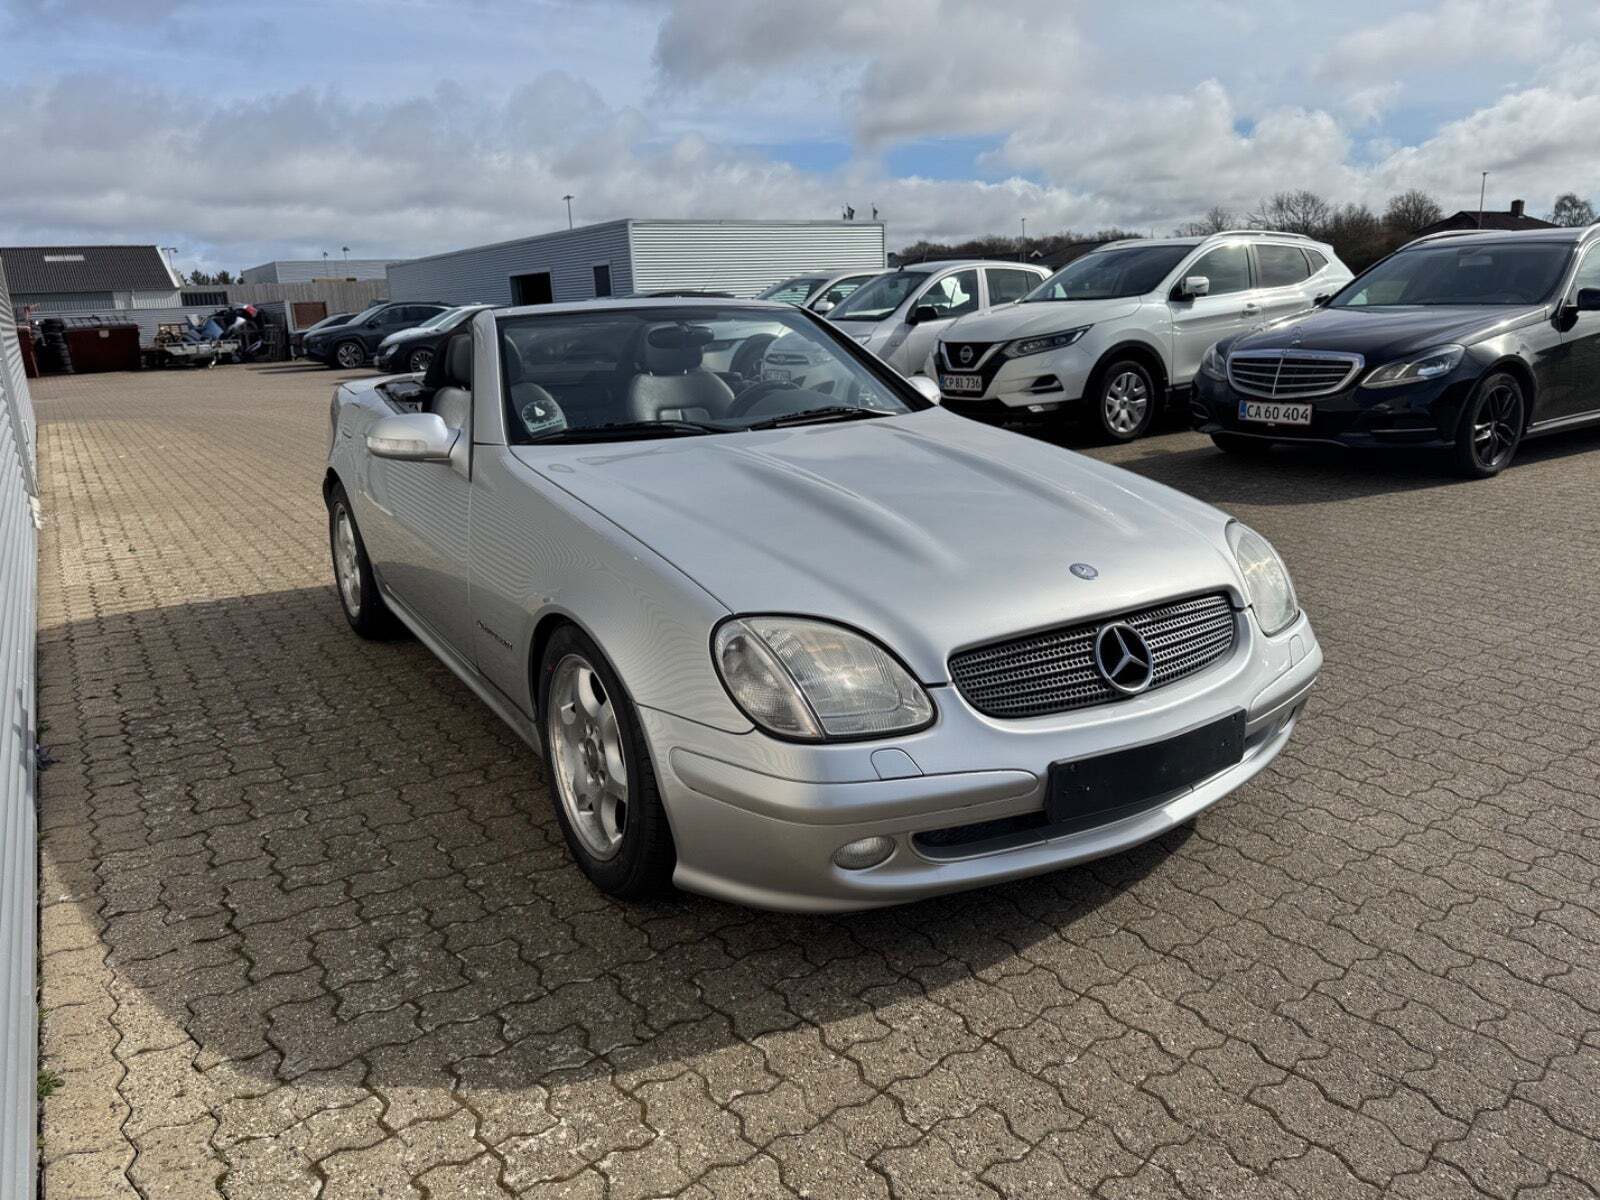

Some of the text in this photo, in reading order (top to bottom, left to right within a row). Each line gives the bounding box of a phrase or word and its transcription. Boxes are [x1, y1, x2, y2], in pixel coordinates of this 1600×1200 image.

[945, 377, 954, 389] CP
[966, 377, 981, 389] 736
[1247, 404, 1309, 422] CA 60 404
